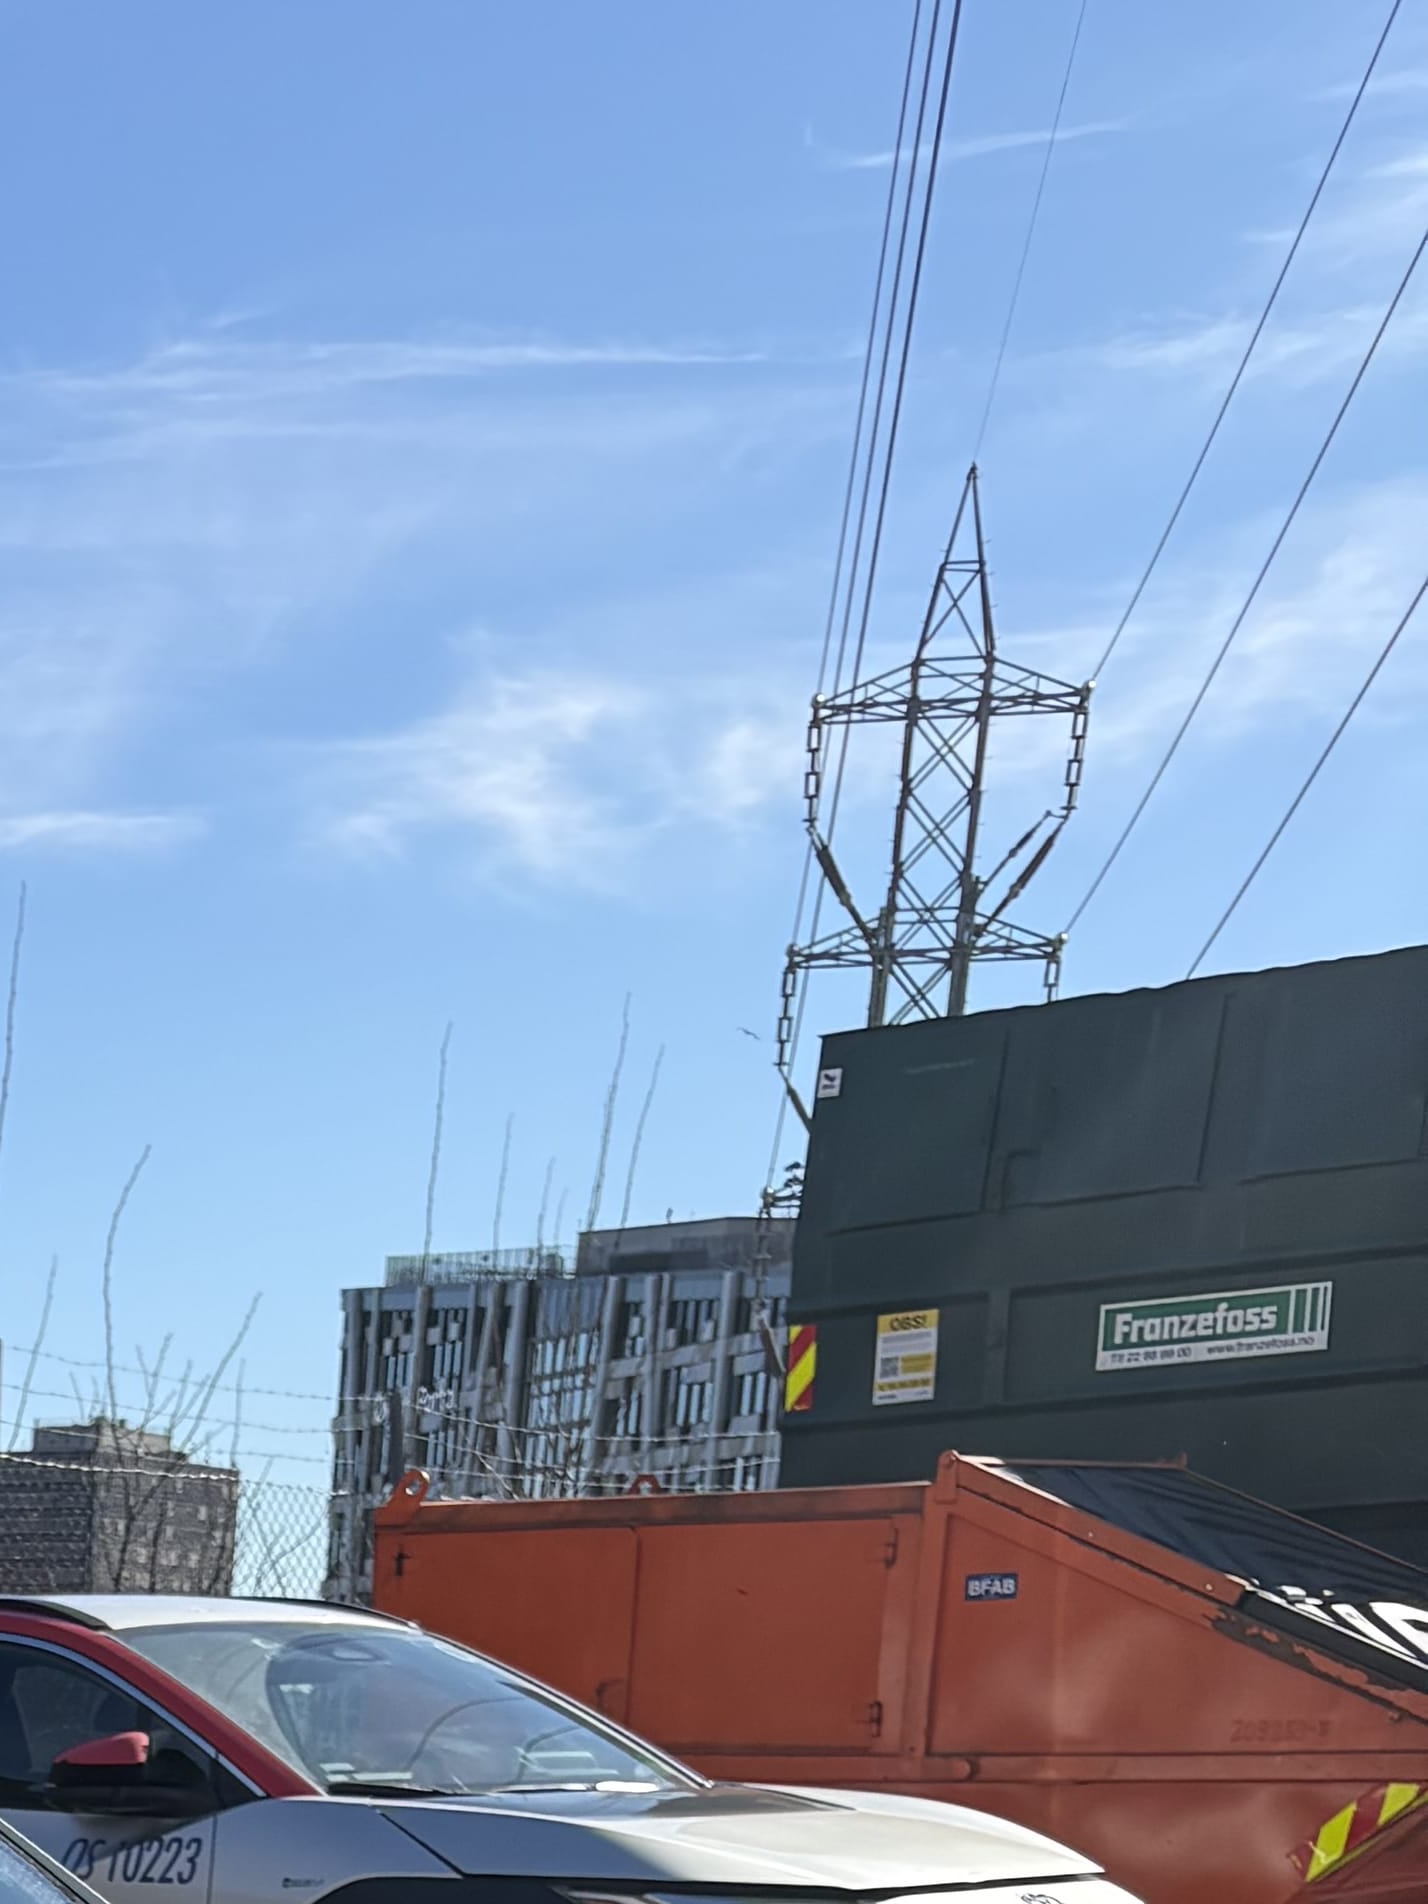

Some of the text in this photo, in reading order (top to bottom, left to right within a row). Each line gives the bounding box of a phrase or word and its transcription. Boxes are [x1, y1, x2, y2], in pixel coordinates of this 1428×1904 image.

[1113, 1301, 1278, 1345] Franzefoss
[967, 1578, 1016, 1597] BFAB
[108, 1836, 203, 1884] 10223
